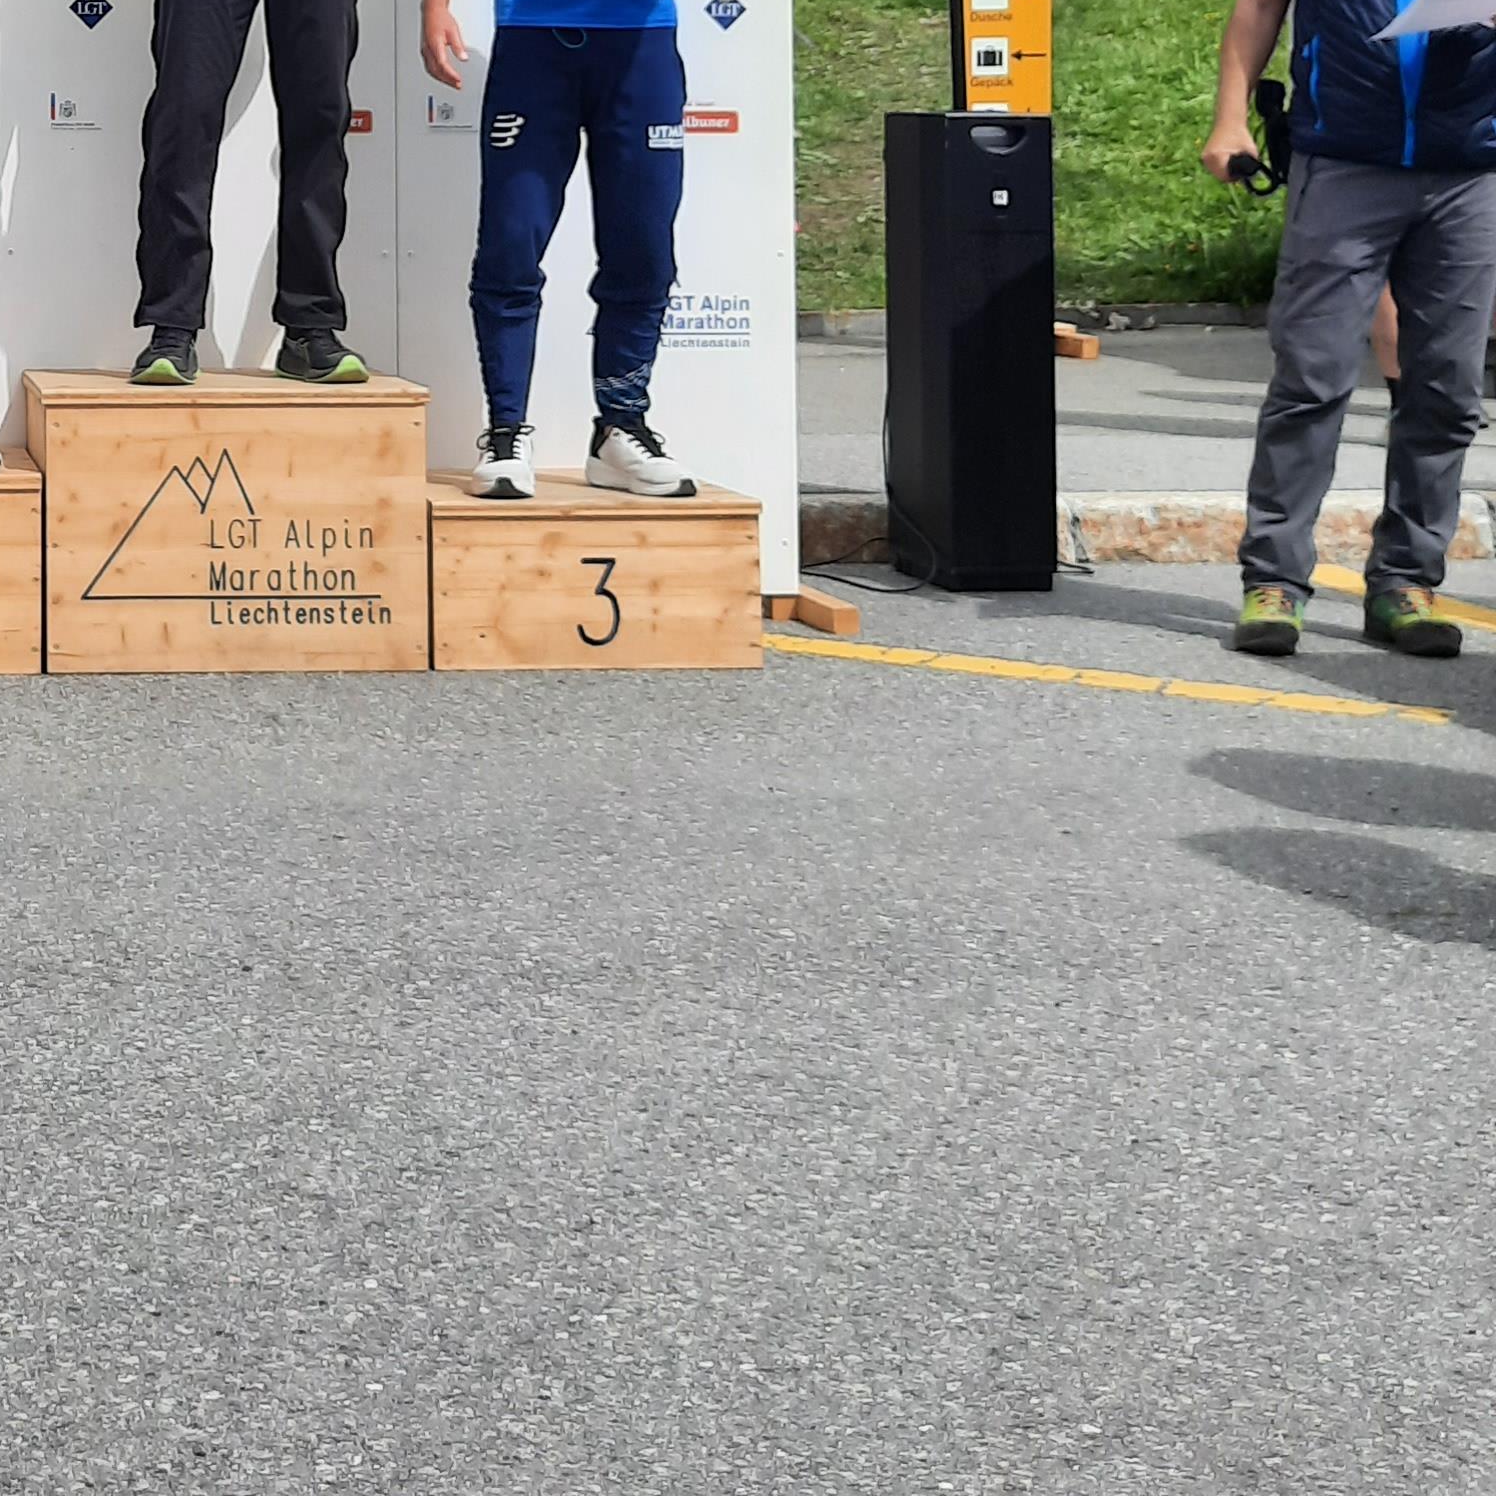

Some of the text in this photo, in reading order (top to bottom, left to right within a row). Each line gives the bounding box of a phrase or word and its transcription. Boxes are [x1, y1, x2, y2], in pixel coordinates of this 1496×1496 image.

[77, 1, 107, 15] LGT
[709, 2, 741, 17] LGT
[970, 12, 1012, 22] Dusche
[668, 295, 750, 314] GT Alpin
[209, 518, 375, 557] LGT Alpin
[209, 560, 356, 592] Marathon
[209, 600, 392, 625] Liechtenstein
[577, 557, 621, 647] 3
